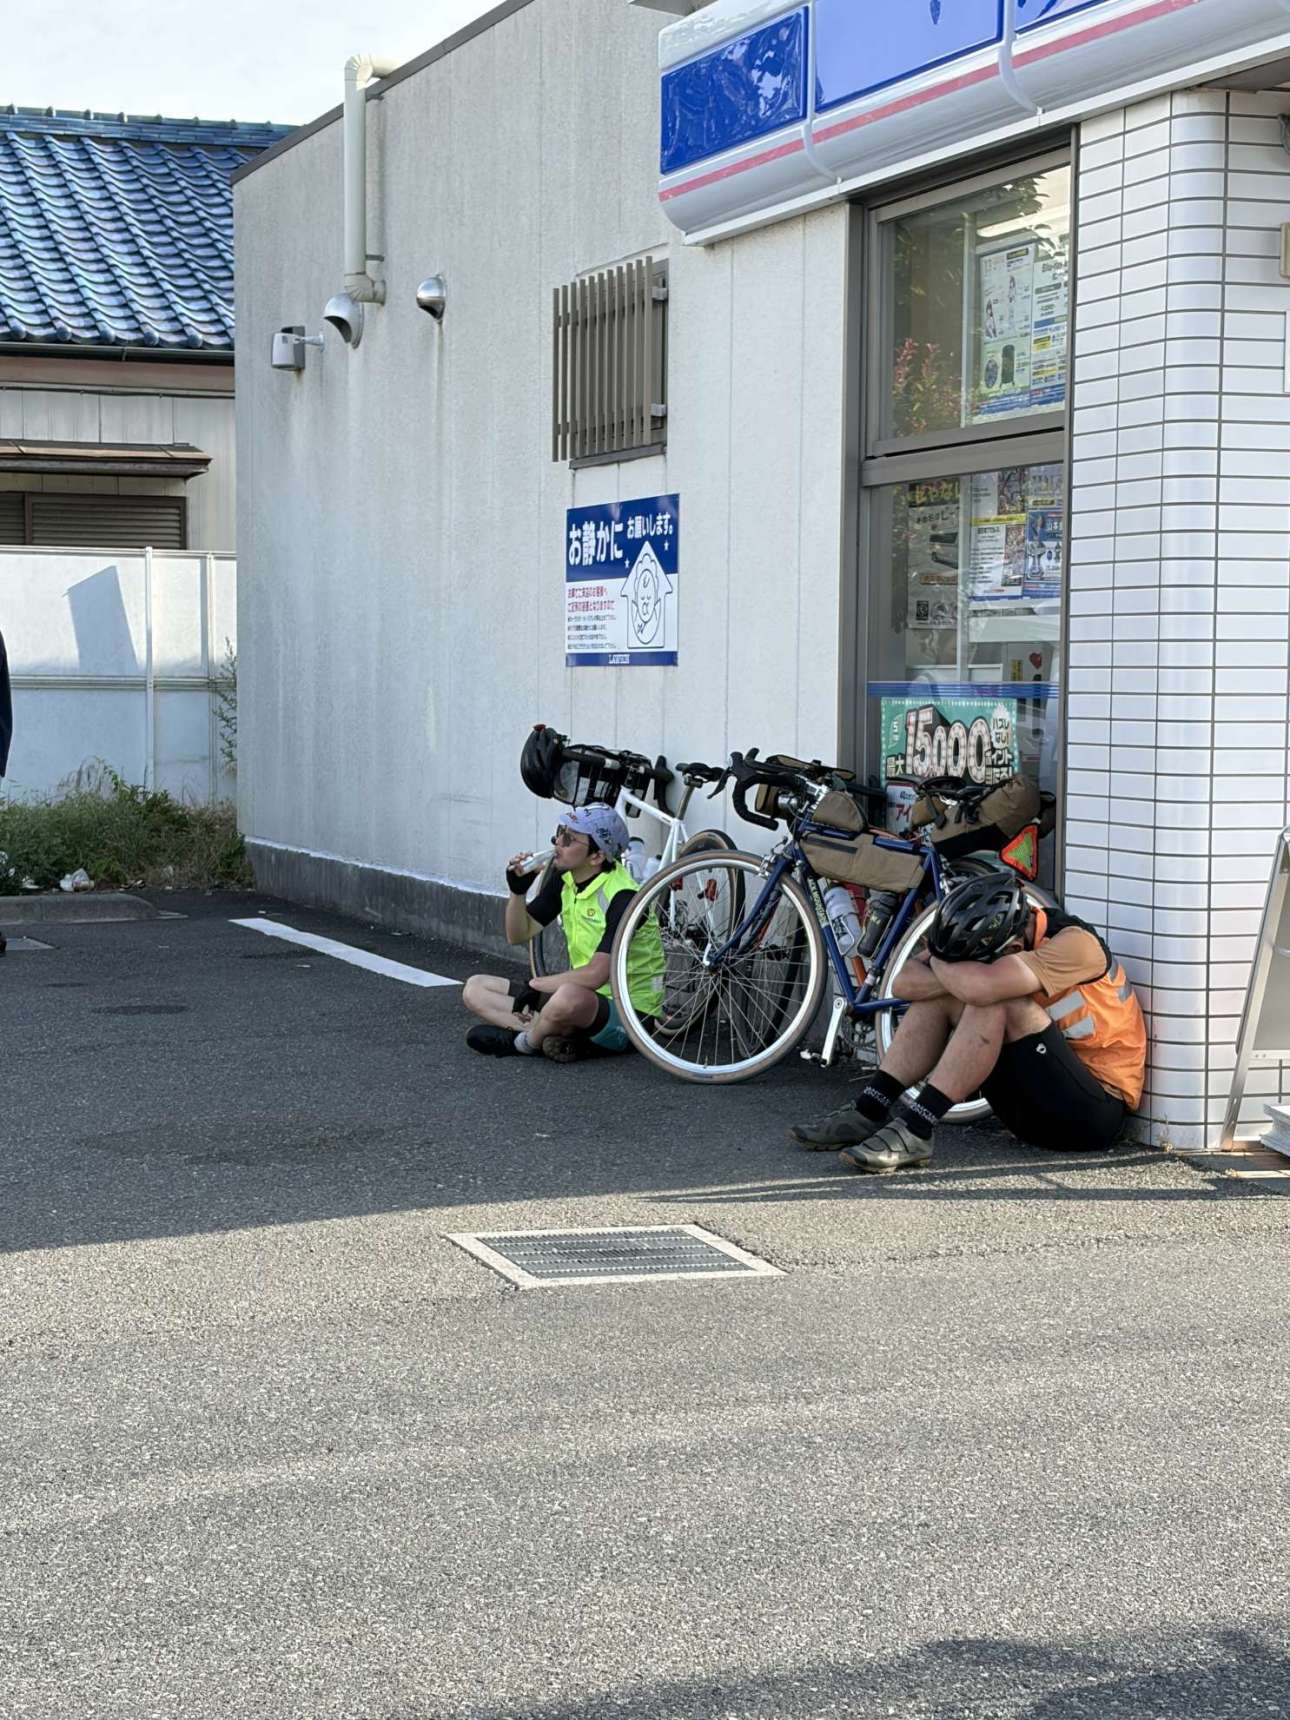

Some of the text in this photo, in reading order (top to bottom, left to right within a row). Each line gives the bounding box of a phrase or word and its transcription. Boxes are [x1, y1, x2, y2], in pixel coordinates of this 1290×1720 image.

[569, 511, 673, 566] お静かに お願いします。
[886, 754, 905, 778] 最大
